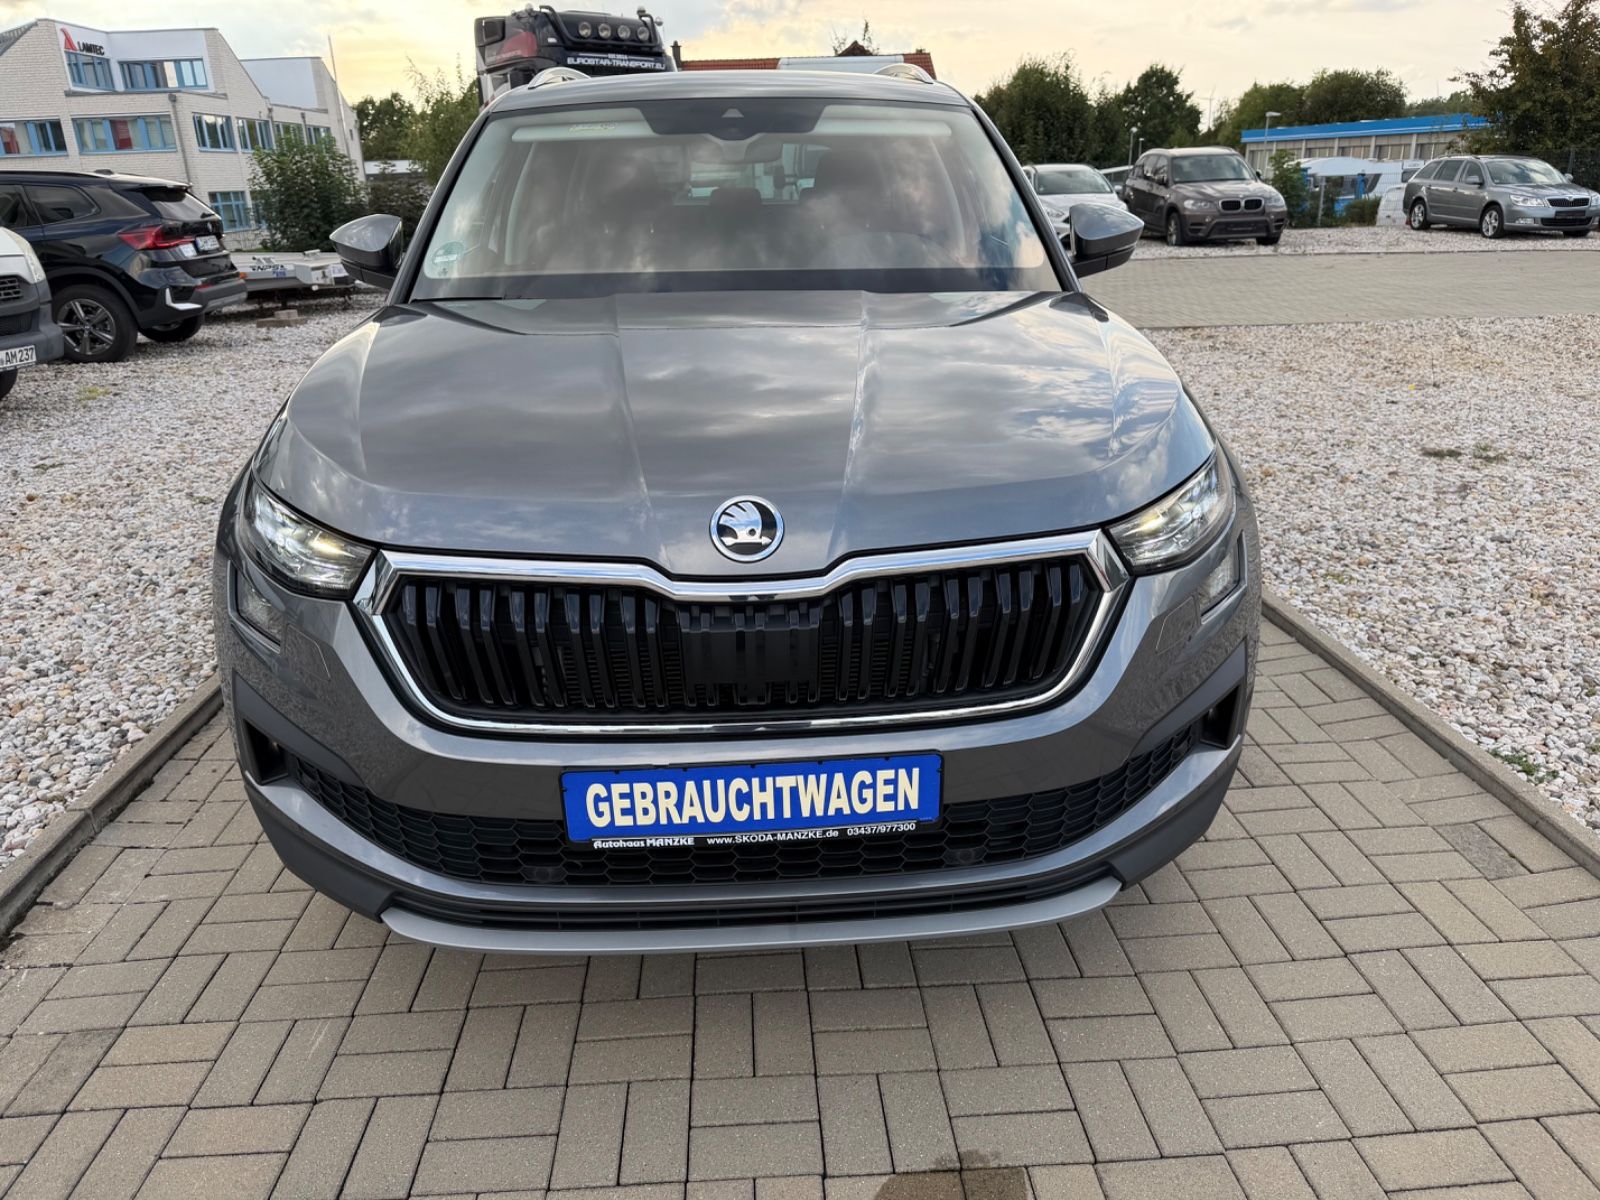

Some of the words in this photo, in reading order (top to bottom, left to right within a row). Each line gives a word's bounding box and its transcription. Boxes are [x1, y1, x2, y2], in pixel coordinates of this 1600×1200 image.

[585, 767, 920, 828] GEBRAUCHTWAGEN
[593, 839, 645, 849] Autohaus
[646, 837, 695, 848] MANZKE
[847, 822, 916, 836] 03437/977300
